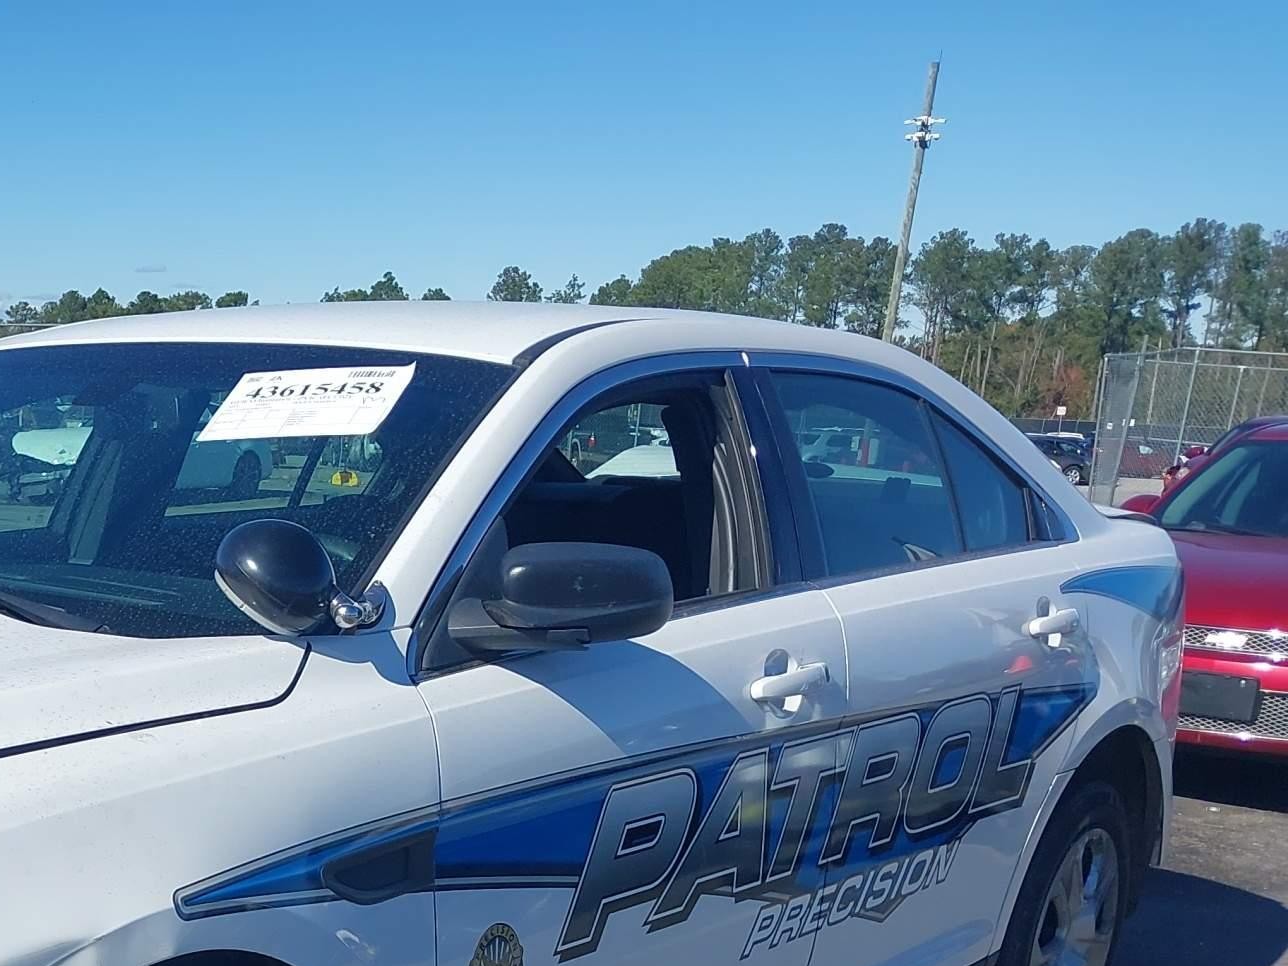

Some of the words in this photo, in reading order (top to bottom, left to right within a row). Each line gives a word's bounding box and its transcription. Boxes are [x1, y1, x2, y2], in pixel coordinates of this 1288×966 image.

[246, 381, 384, 399] 43615458
[554, 683, 1036, 962] PATROL
[739, 838, 962, 961] PRECISION
